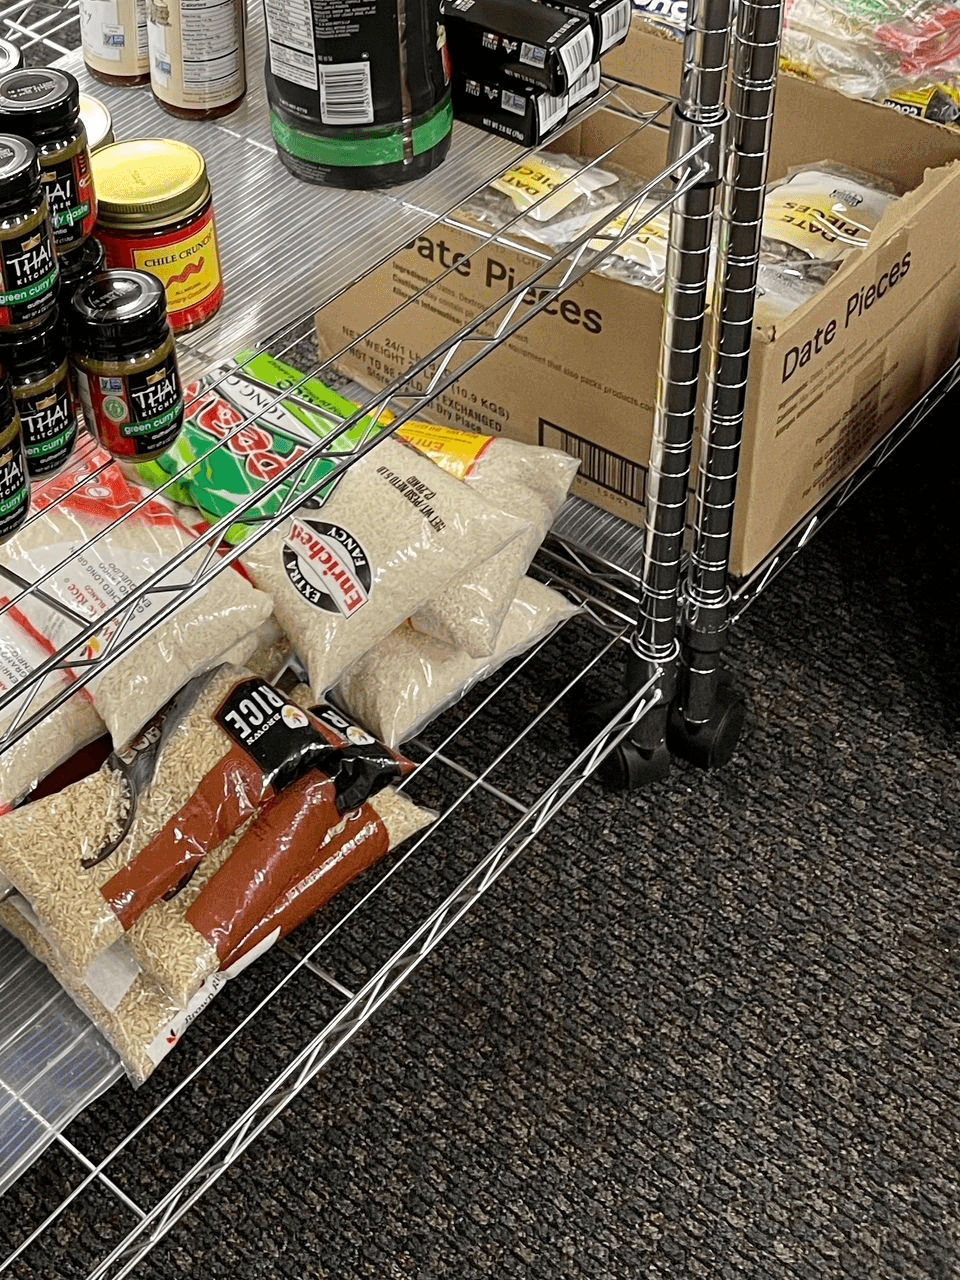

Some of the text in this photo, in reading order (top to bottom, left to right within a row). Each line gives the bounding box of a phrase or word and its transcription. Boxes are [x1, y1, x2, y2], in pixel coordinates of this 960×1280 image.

[781, 214, 838, 244] DATE
[782, 201, 861, 238] PIECES
[6, 238, 53, 277] THAI
[16, 261, 54, 286] KITCHEN
[143, 254, 178, 268] CHILE
[28, 278, 54, 296] curry
[781, 251, 912, 384] Date Pieces
[131, 372, 177, 409] THAI
[141, 394, 179, 418] KITCHEN
[20, 398, 68, 433] THAI
[29, 418, 70, 442] KITCHEN
[124, 410, 175, 436] green curry
[440, 396, 503, 434] EXCHANGED
[41, 434, 63, 454] curry
[0, 495, 22, 514] curry
[325, 526, 365, 568] FANCY
[286, 559, 322, 604] EXTRA
[288, 523, 368, 612] Enriched
[224, 684, 284, 740] RICE
[246, 712, 282, 747] BROWN
